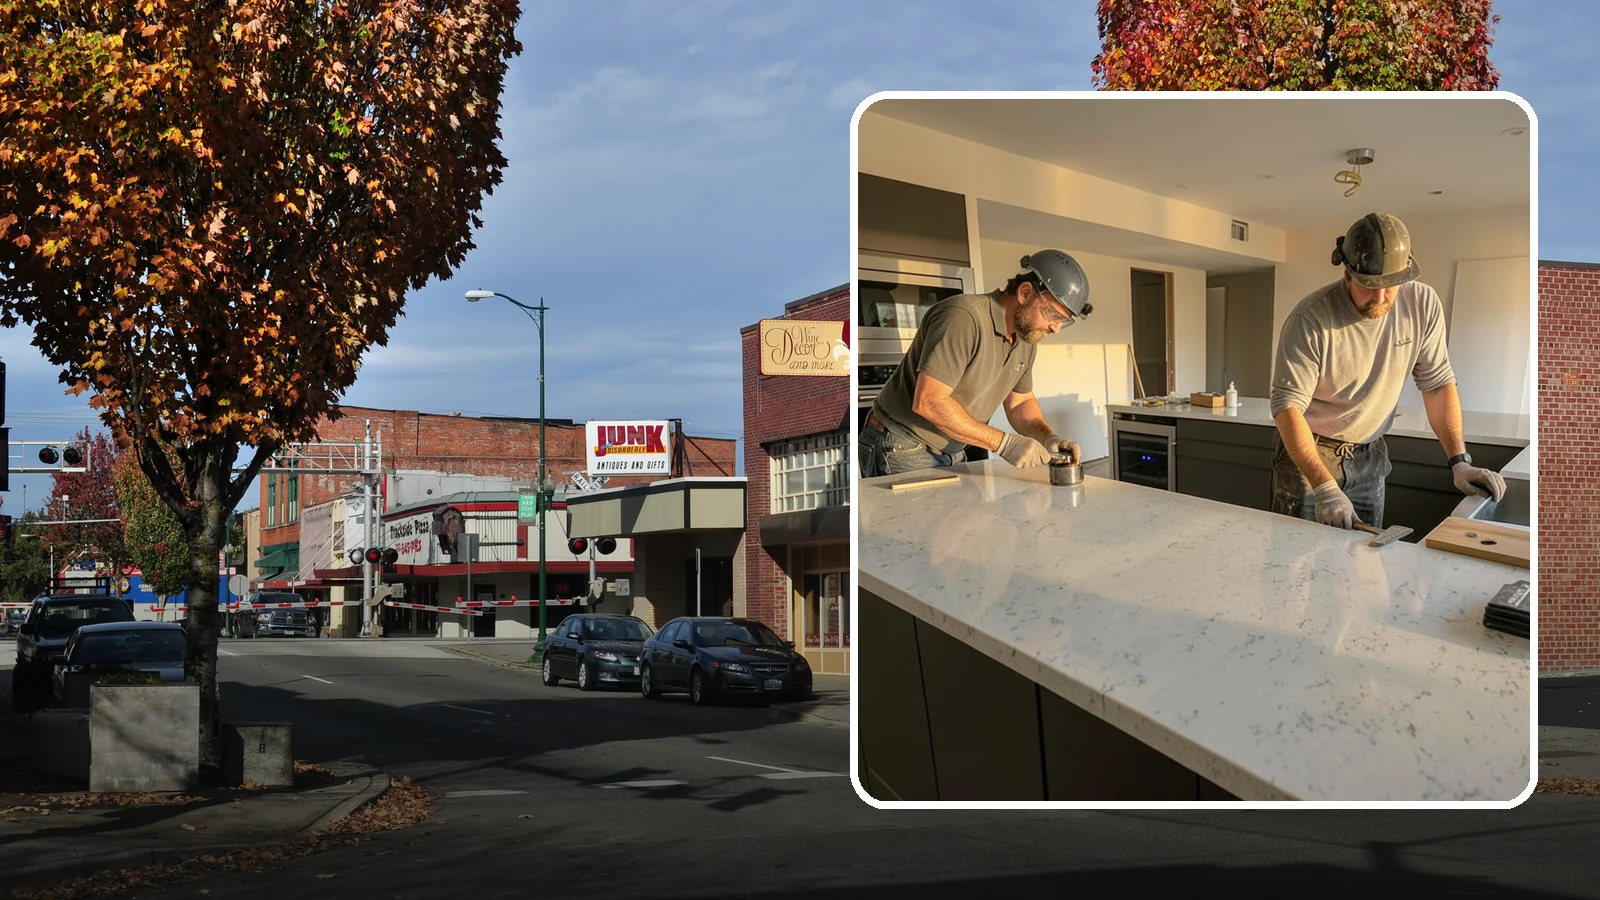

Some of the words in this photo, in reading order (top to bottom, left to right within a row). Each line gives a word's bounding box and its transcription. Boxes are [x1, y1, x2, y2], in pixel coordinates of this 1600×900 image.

[595, 425, 665, 457] JUNK
[597, 461, 628, 470] ANTIQUES
[631, 461, 644, 470] AND
[647, 461, 666, 470] GIFTS
[415, 519, 429, 535] Pizza
